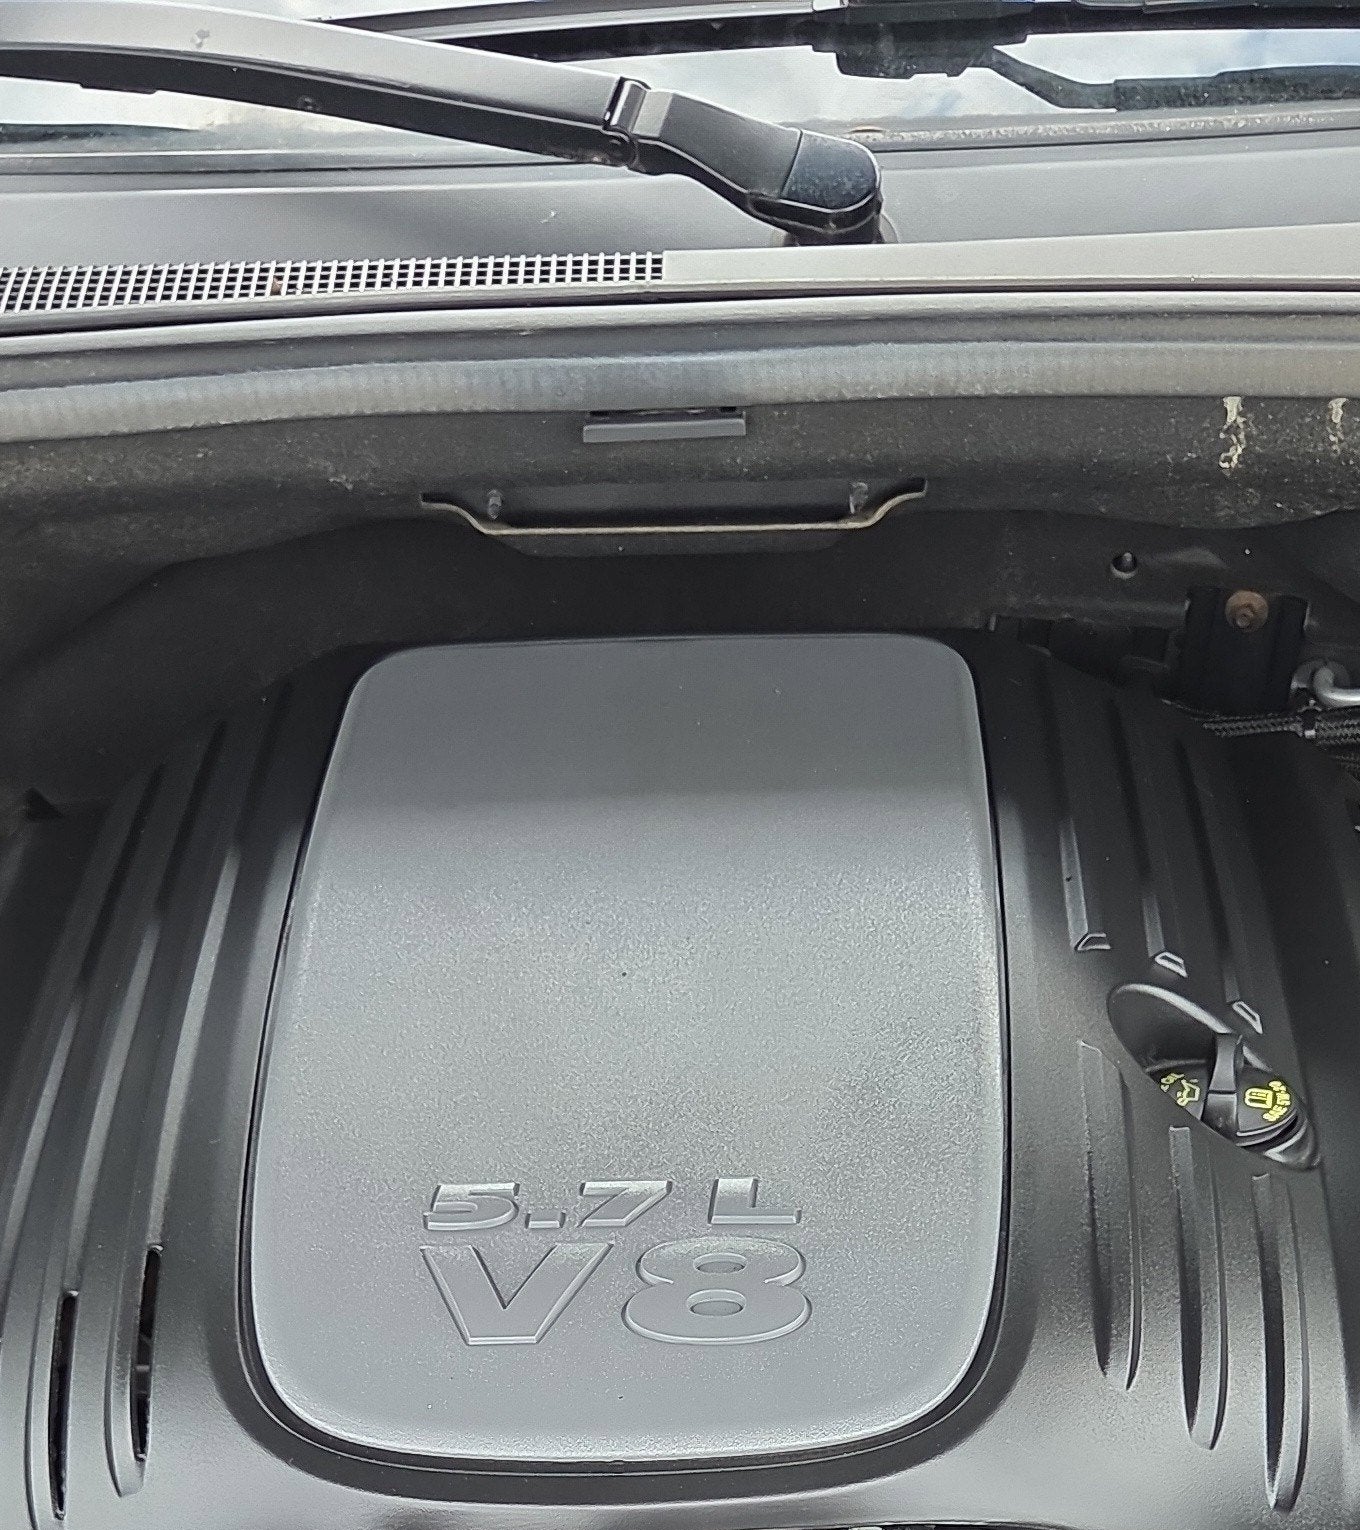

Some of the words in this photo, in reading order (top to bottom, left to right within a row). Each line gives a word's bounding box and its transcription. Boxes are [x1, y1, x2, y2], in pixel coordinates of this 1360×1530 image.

[422, 1180, 673, 1231] 5.7
[707, 1177, 802, 1225] L
[419, 1235, 812, 1345] V8
